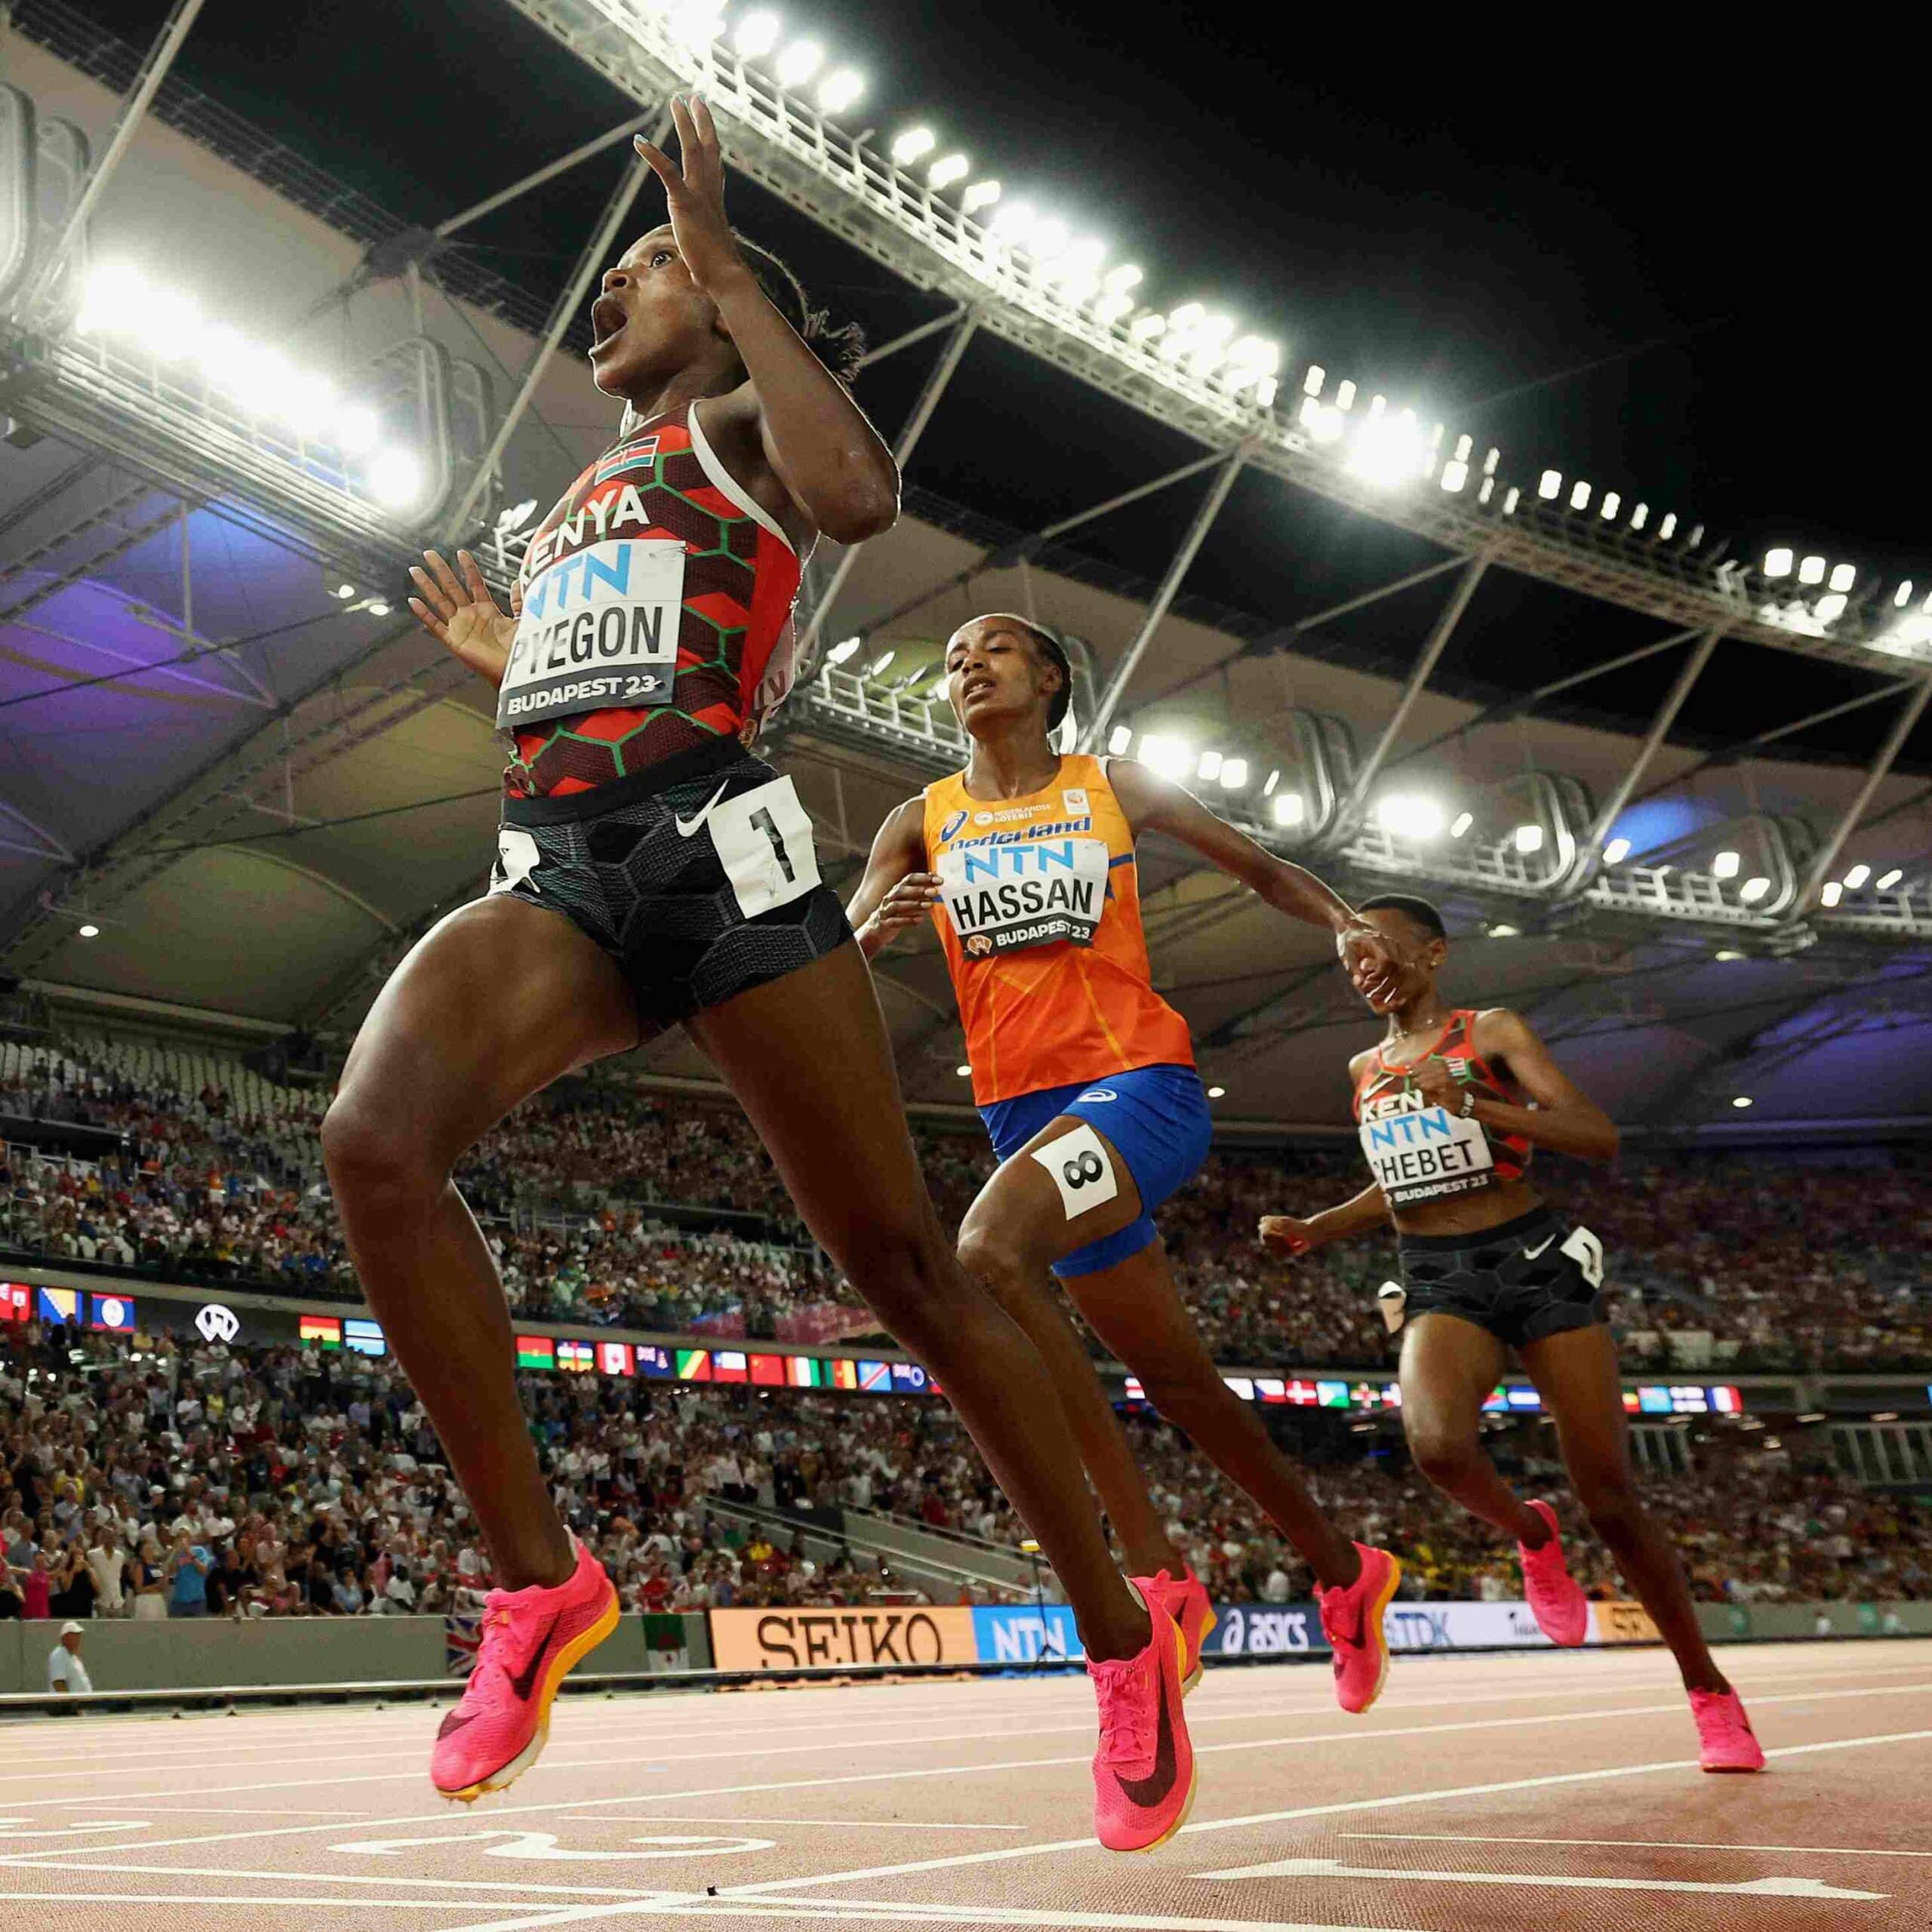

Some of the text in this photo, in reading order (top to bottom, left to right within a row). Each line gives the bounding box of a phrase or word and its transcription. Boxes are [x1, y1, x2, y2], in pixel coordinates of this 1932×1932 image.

[507, 675, 660, 715] BUDAPEST 23
[749, 807, 795, 883] 1
[964, 841, 1074, 884] NTN
[952, 878, 1094, 930] HASSAN
[995, 919, 1091, 947] BUDAPEST 23
[1370, 1107, 1451, 1151] NTN
[1063, 1150, 1103, 1189] 8
[1374, 1139, 1475, 1184] HEBET
[1395, 1178, 1469, 1203] BUDAPEST
[756, 1613, 942, 1667] SEIKO
[992, 1617, 1067, 1662] NTN
